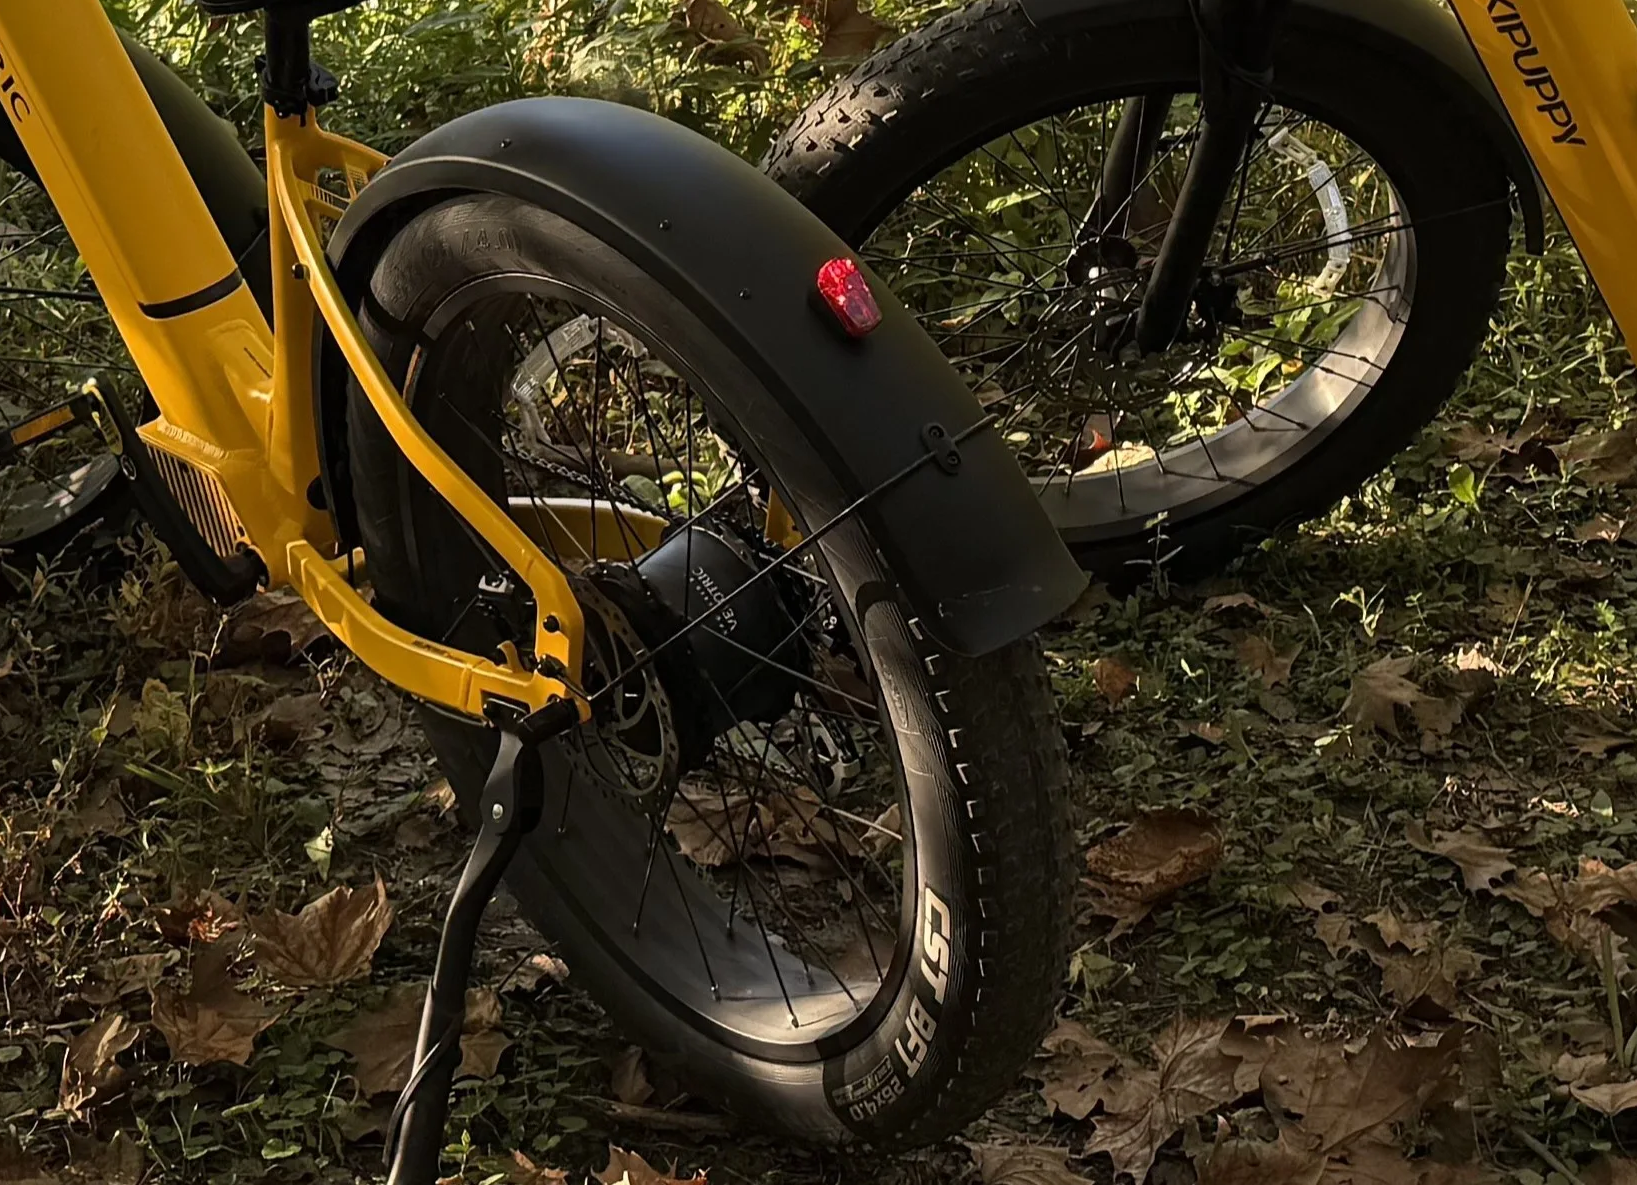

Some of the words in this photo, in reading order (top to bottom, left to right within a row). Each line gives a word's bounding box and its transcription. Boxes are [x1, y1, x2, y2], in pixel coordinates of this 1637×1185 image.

[921, 887, 951, 1006] CST
[895, 994, 937, 1078] BFT
[848, 1075, 905, 1122] 26x4.0
